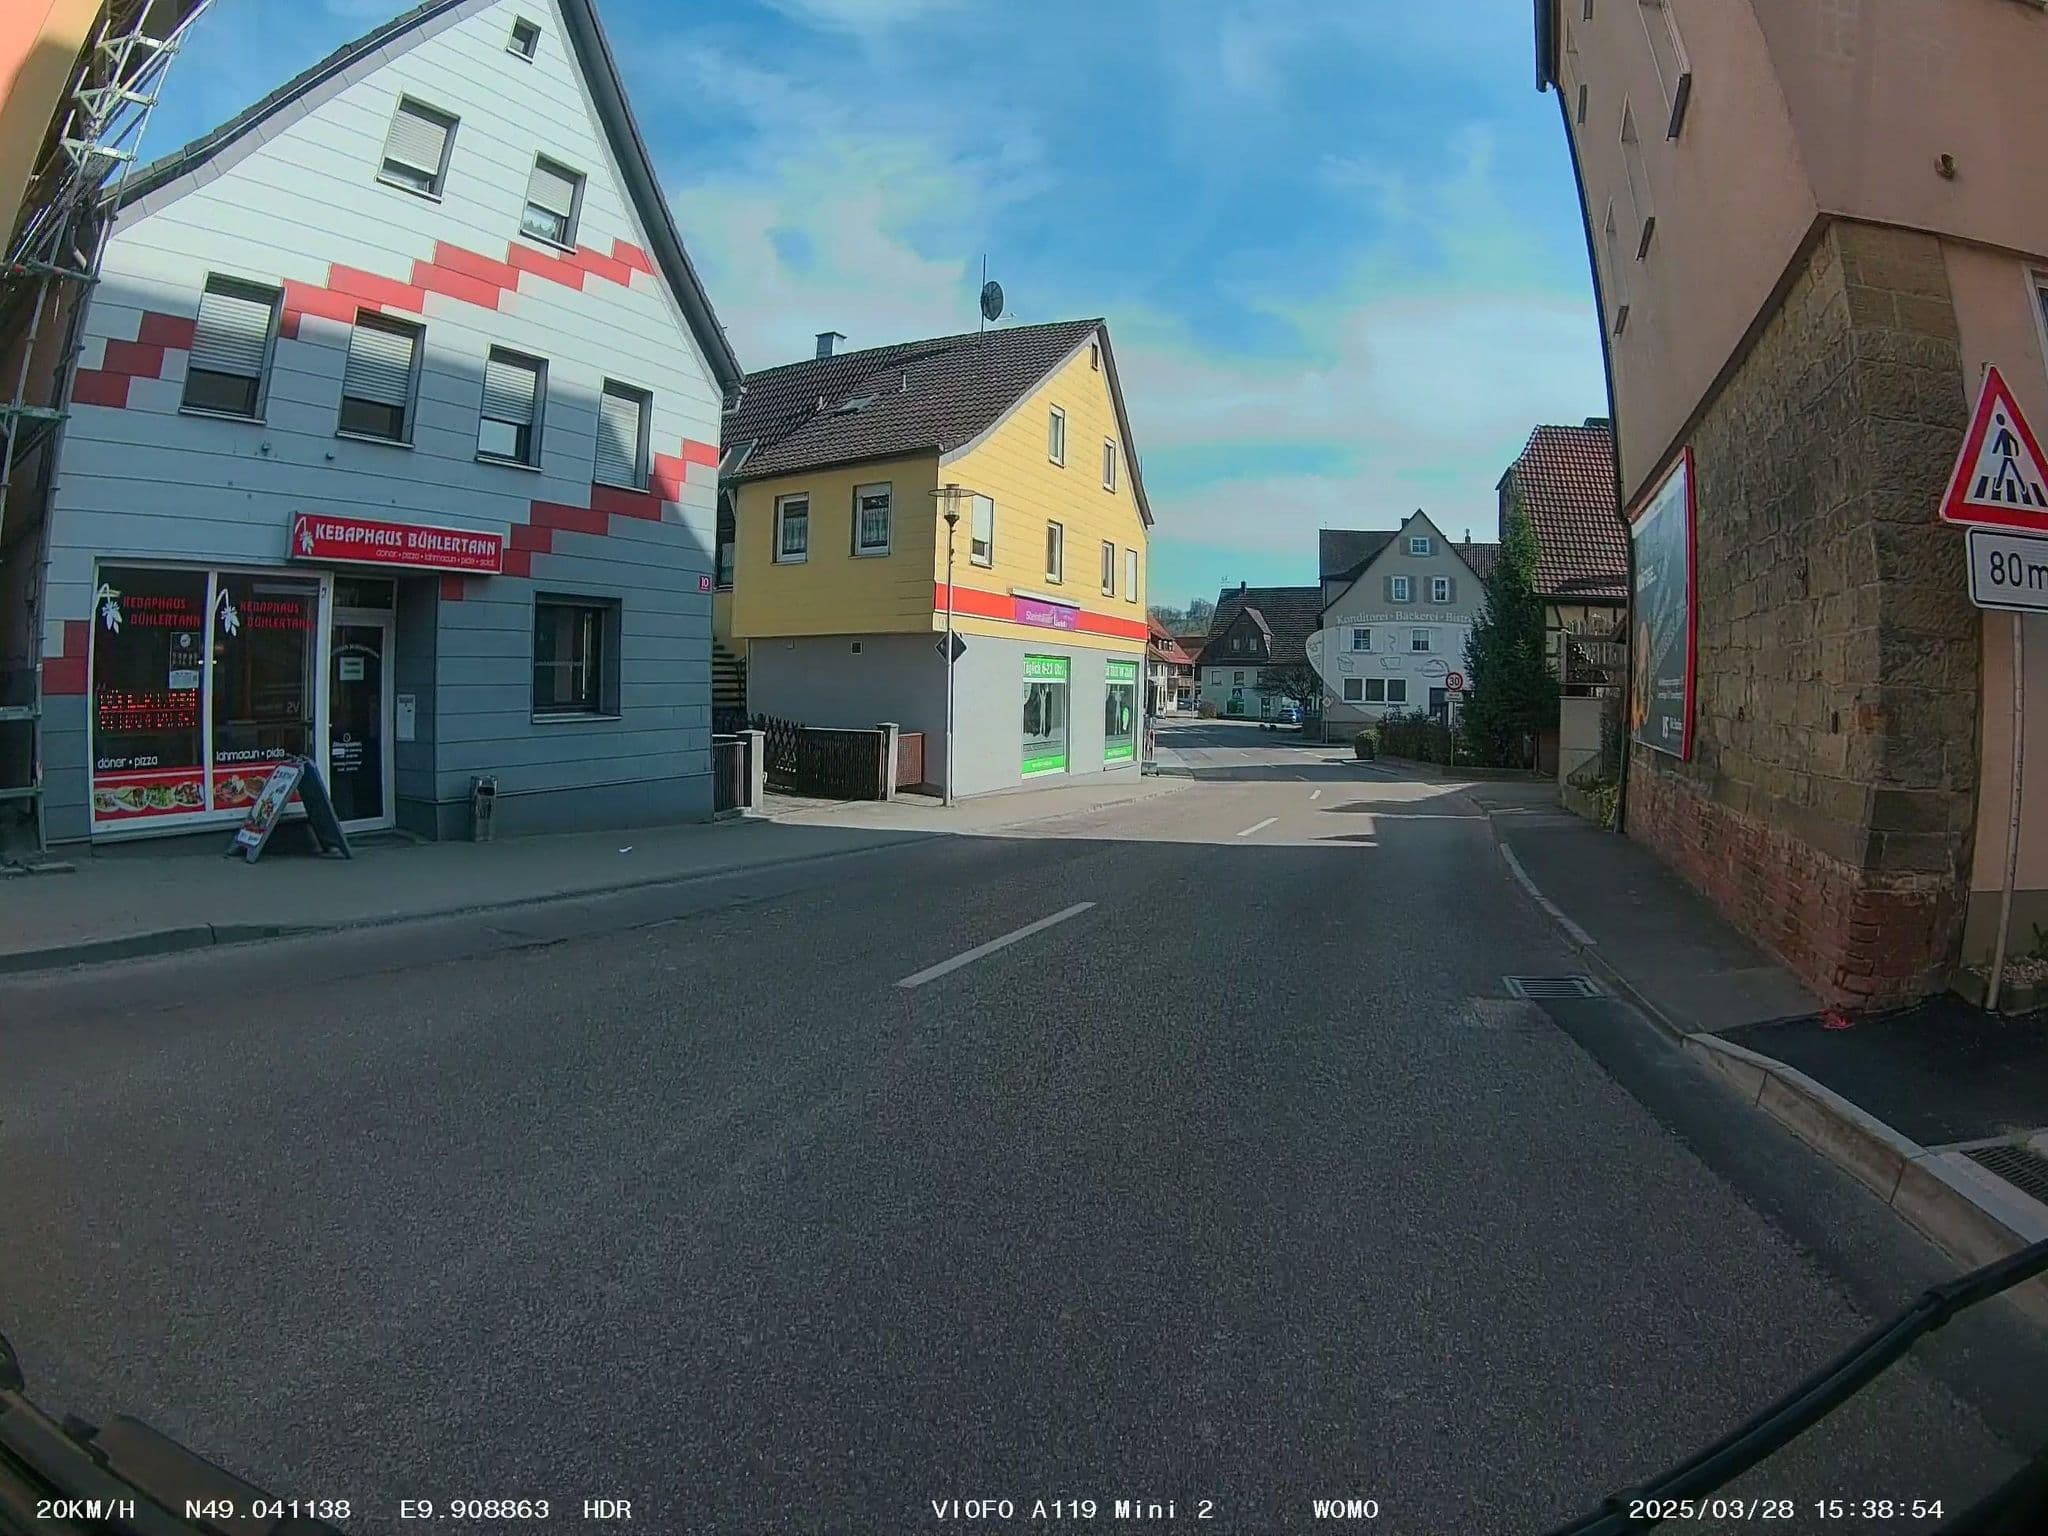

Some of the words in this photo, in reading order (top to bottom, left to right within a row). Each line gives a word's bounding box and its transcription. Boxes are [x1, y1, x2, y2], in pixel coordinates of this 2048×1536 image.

[315, 523, 403, 546] KEBAPHAUS
[408, 532, 496, 556] BÜHLERTANN
[701, 576, 709, 588] 10
[123, 596, 187, 610] KEBAPHAUS
[1336, 611, 1388, 625] Konditorei
[1395, 610, 1439, 621] Bäckerei
[1449, 676, 1460, 686] 30
[216, 751, 260, 760] lahmacun
[266, 748, 285, 757] pide
[97, 758, 126, 769] döner
[134, 756, 158, 768] pizza
